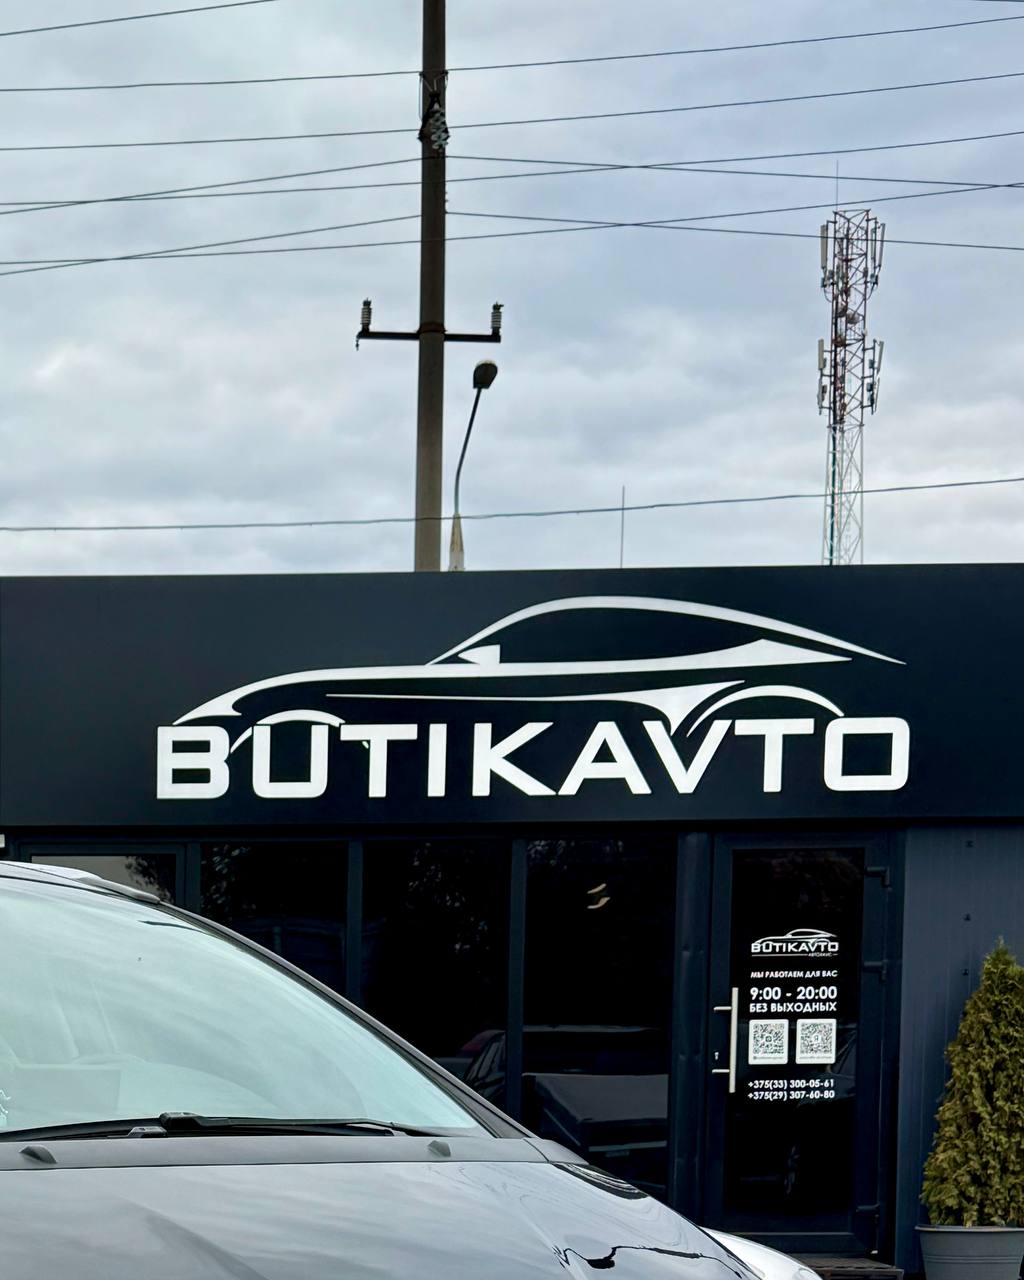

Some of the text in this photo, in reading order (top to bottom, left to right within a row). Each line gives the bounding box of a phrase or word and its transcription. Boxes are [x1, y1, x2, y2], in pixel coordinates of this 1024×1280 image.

[156, 714, 910, 799] BUTIKAVTO
[751, 941, 839, 953] BUTIKAVTO
[765, 970, 804, 978] РАБОТАЕМ
[805, 970, 821, 978] ДЛЯ
[822, 969, 838, 977] ВАС
[750, 986, 782, 1000] 9:00
[796, 985, 838, 1000] 20:00
[749, 1001, 837, 1013] БЕЗ ВЫХОДНЫХ
[748, 1078, 834, 1090] +375(33) 300-05-61
[748, 1090, 835, 1101] +375(29) 307-60-80
